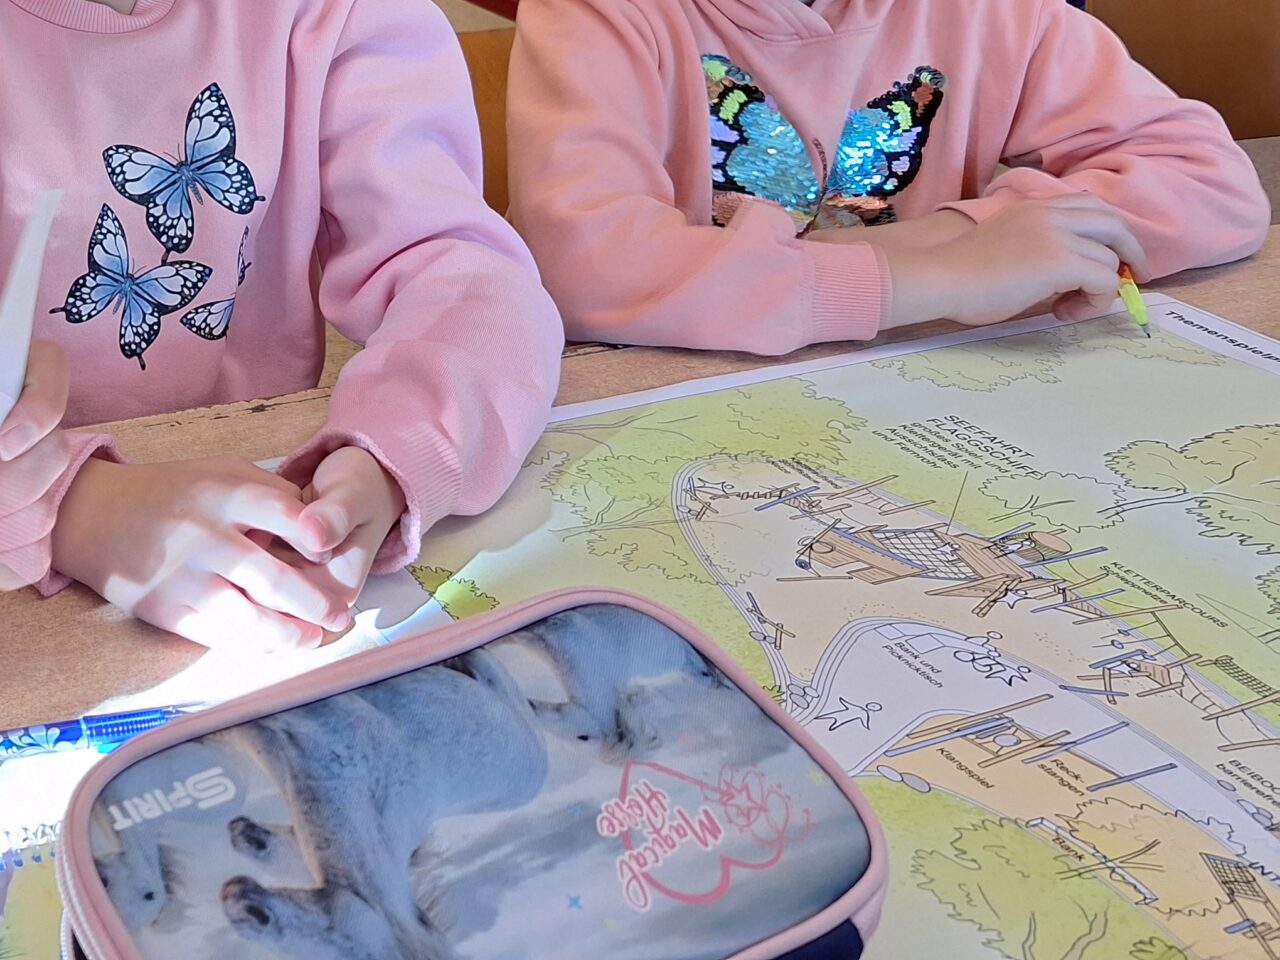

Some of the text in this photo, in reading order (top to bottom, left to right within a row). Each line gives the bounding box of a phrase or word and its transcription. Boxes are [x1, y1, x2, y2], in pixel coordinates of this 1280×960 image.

[1165, 310, 1280, 363] Themenspielp
[871, 429, 943, 470] und Fernrohr
[885, 427, 960, 469] Aussichtsfass
[898, 424, 982, 470] Klettergerät mit
[910, 421, 1011, 474] großes Spiel- und
[925, 417, 1044, 478] FLAGGSCHIFF
[944, 414, 1035, 458] SEEFAHRT
[1099, 564, 1169, 605] Schleppnetze
[1109, 561, 1229, 628] KLETTERPARCOURS
[882, 644, 943, 689] Picknicktisch
[894, 641, 942, 674] Bank und
[936, 747, 996, 789] Klangspiel
[1037, 763, 1086, 797] stangen
[1050, 758, 1085, 784] Reck-
[108, 766, 236, 831] SPIRIT
[618, 807, 723, 910] Magical
[1052, 836, 1086, 862] Bank
